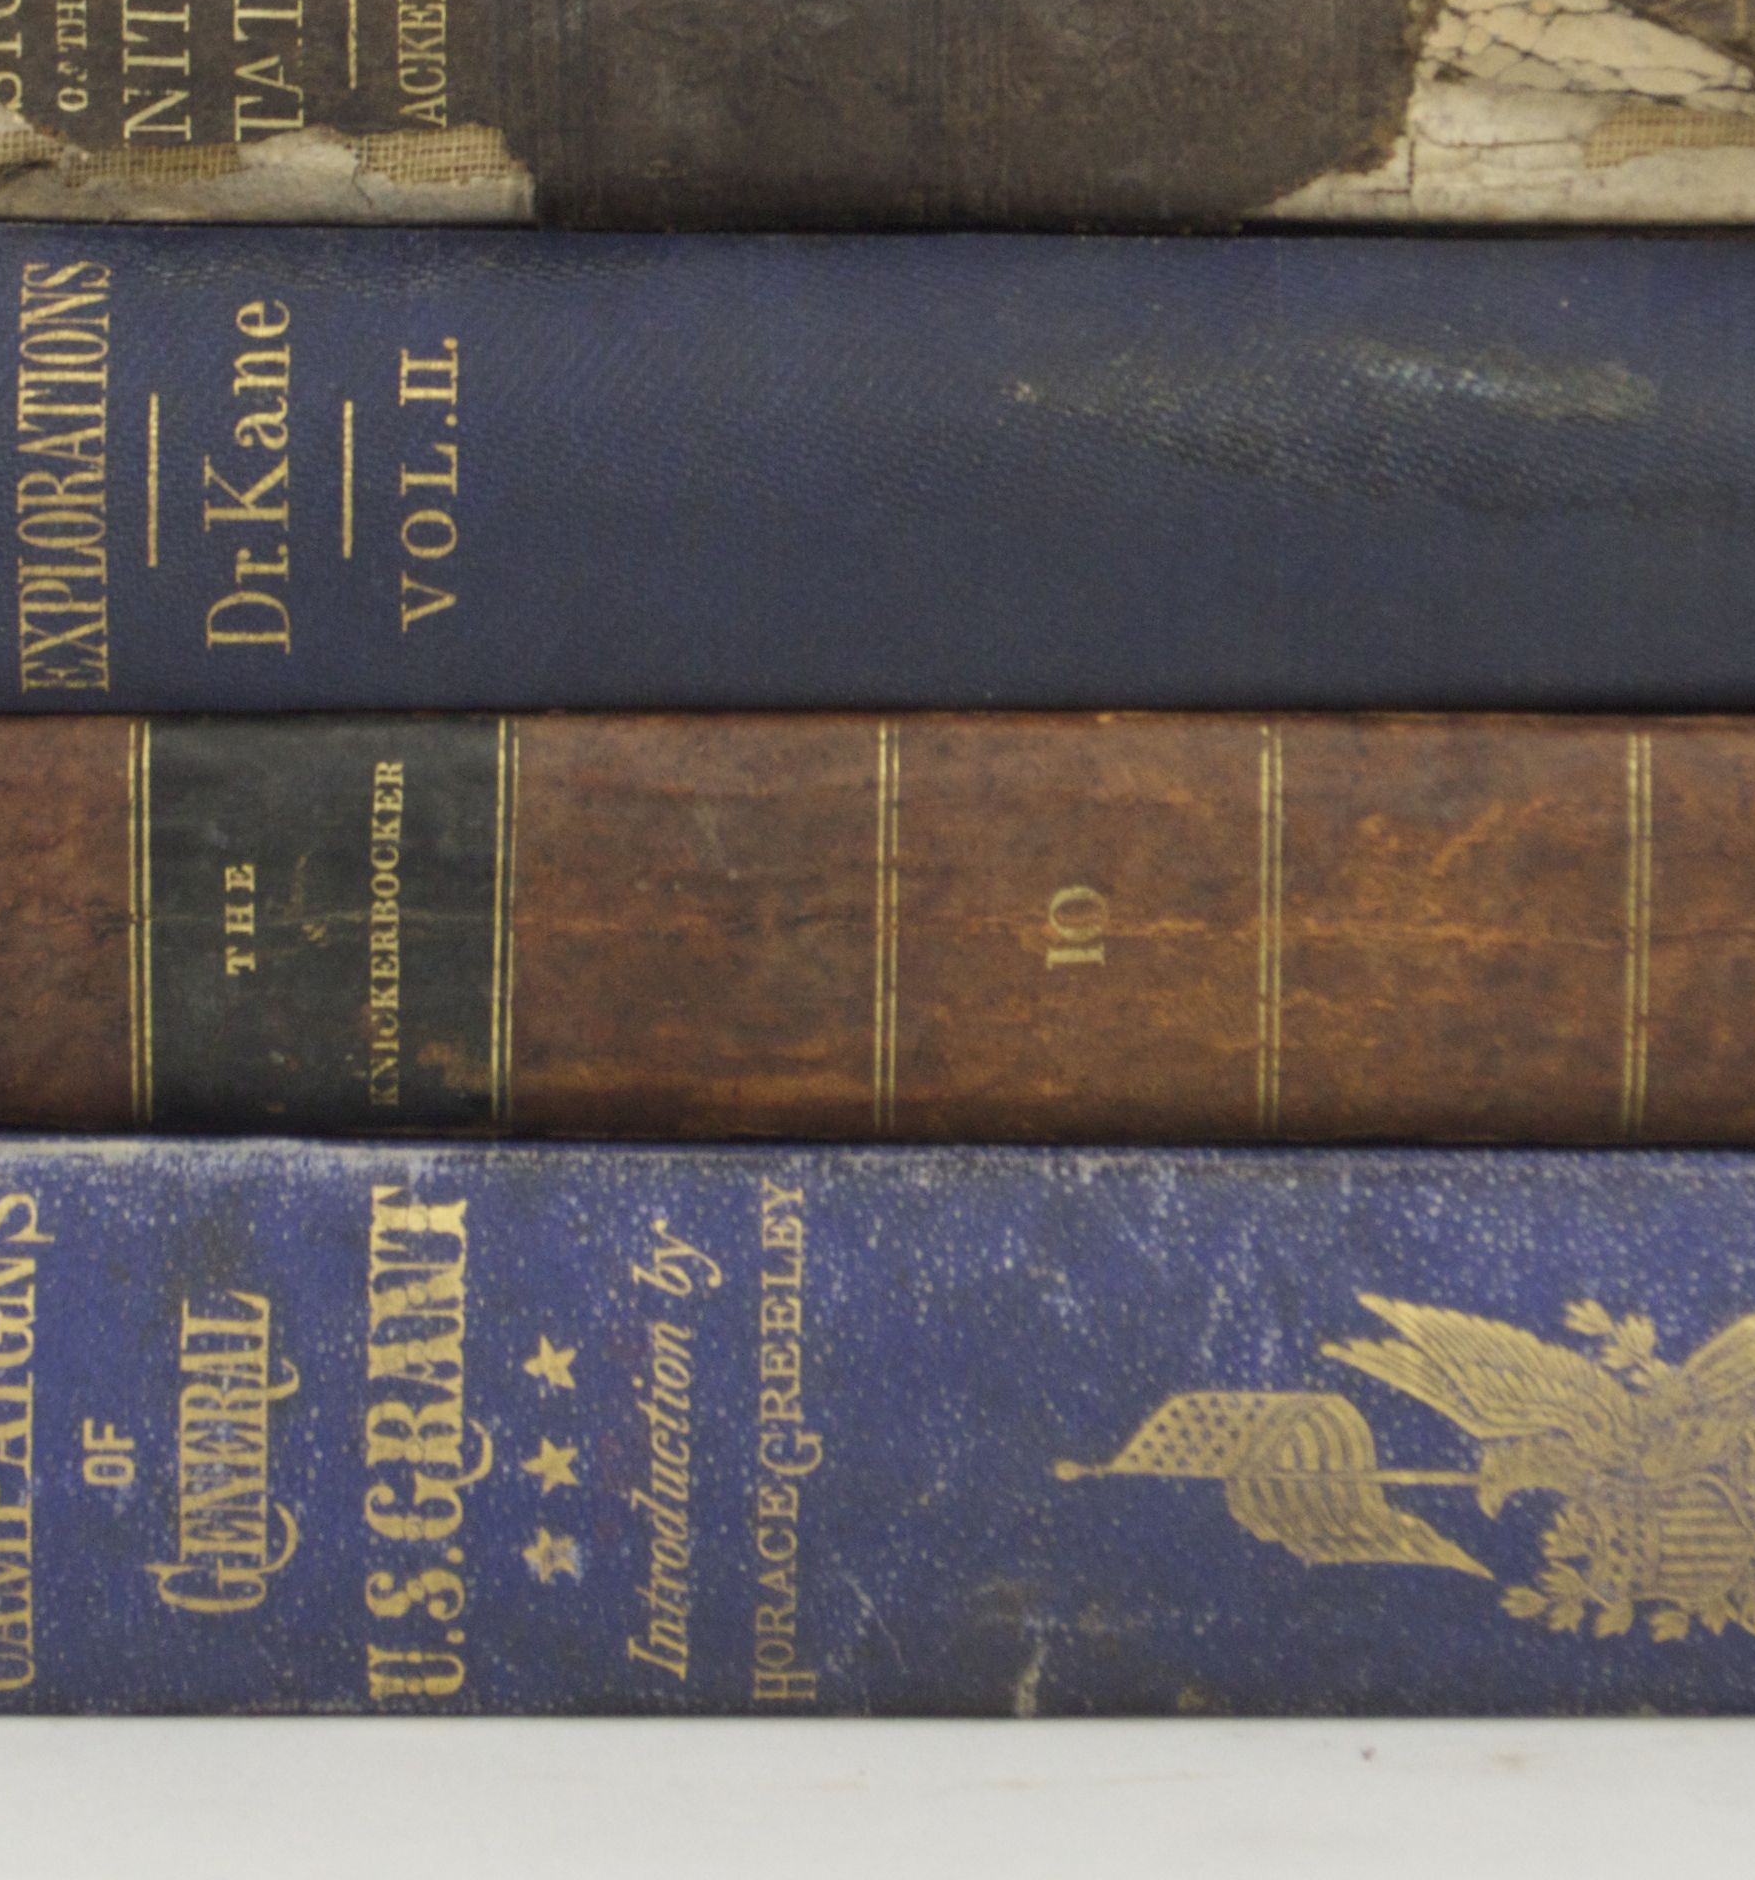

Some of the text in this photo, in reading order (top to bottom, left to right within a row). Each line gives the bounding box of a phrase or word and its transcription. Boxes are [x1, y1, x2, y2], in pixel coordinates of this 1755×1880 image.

[17, 259, 113, 694] EXPLORATIONS
[224, 861, 256, 977] THE
[369, 759, 405, 1107] KNICKERBOCKER
[1045, 884, 1110, 971] 10
[82, 1416, 136, 1489] OF
[144, 1288, 301, 1615] GENERAL
[626, 1212, 722, 1681] Introduction by
[751, 1174, 824, 1702] HORACE GREELEY
